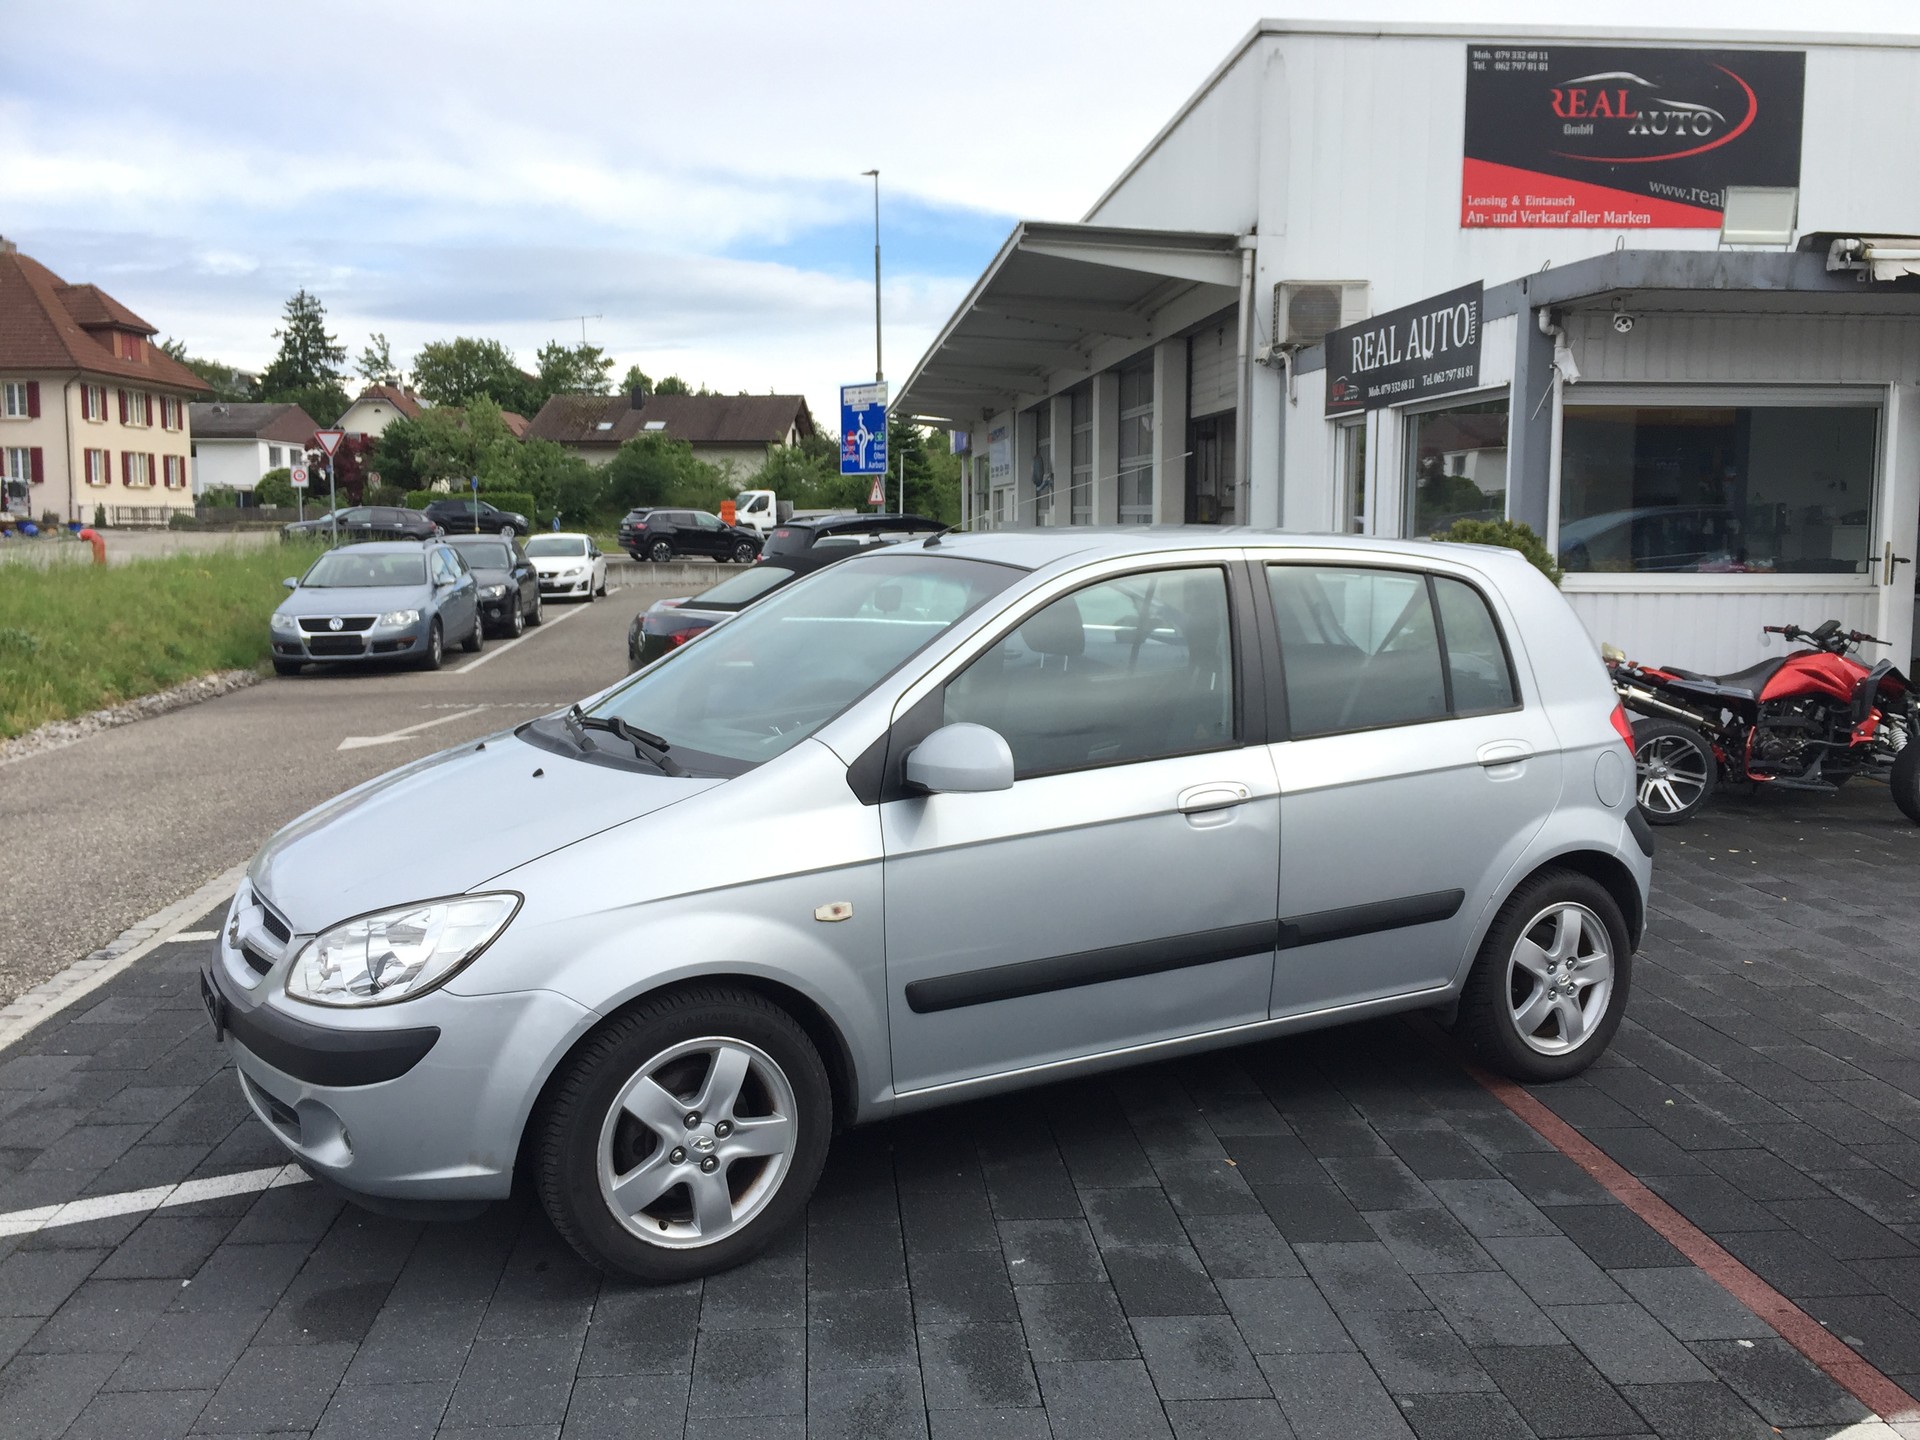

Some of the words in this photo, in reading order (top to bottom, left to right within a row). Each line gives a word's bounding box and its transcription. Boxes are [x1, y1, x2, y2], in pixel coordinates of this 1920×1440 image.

[1494, 50, 1511, 60] 079
[1512, 50, 1527, 60] 332
[1539, 51, 1549, 61] 11
[1494, 61, 1510, 71] 062
[1511, 61, 1527, 71] 797
[1538, 62, 1549, 72] 81
[1551, 88, 1638, 119] REAL
[1563, 123, 1594, 136] GmbH
[1628, 110, 1713, 136] AUTO
[1467, 195, 1508, 208] Leasing
[1511, 195, 1521, 207] &
[1525, 195, 1576, 207] Eintausch
[1467, 211, 1489, 224] An-
[1493, 210, 1517, 224] und
[1520, 210, 1569, 224] Verkauf
[1571, 211, 1600, 224] aller
[1603, 211, 1651, 224] Marken
[1468, 301, 1477, 345] GmbH
[1352, 325, 1401, 374] REAL
[1405, 303, 1469, 360] AUTO
[1422, 373, 1434, 386] Tel.
[1433, 371, 1445, 384] 062
[1445, 368, 1457, 382] 797
[1456, 367, 1465, 379] 81
[1465, 365, 1474, 377] 81
[1408, 378, 1415, 389] 11
